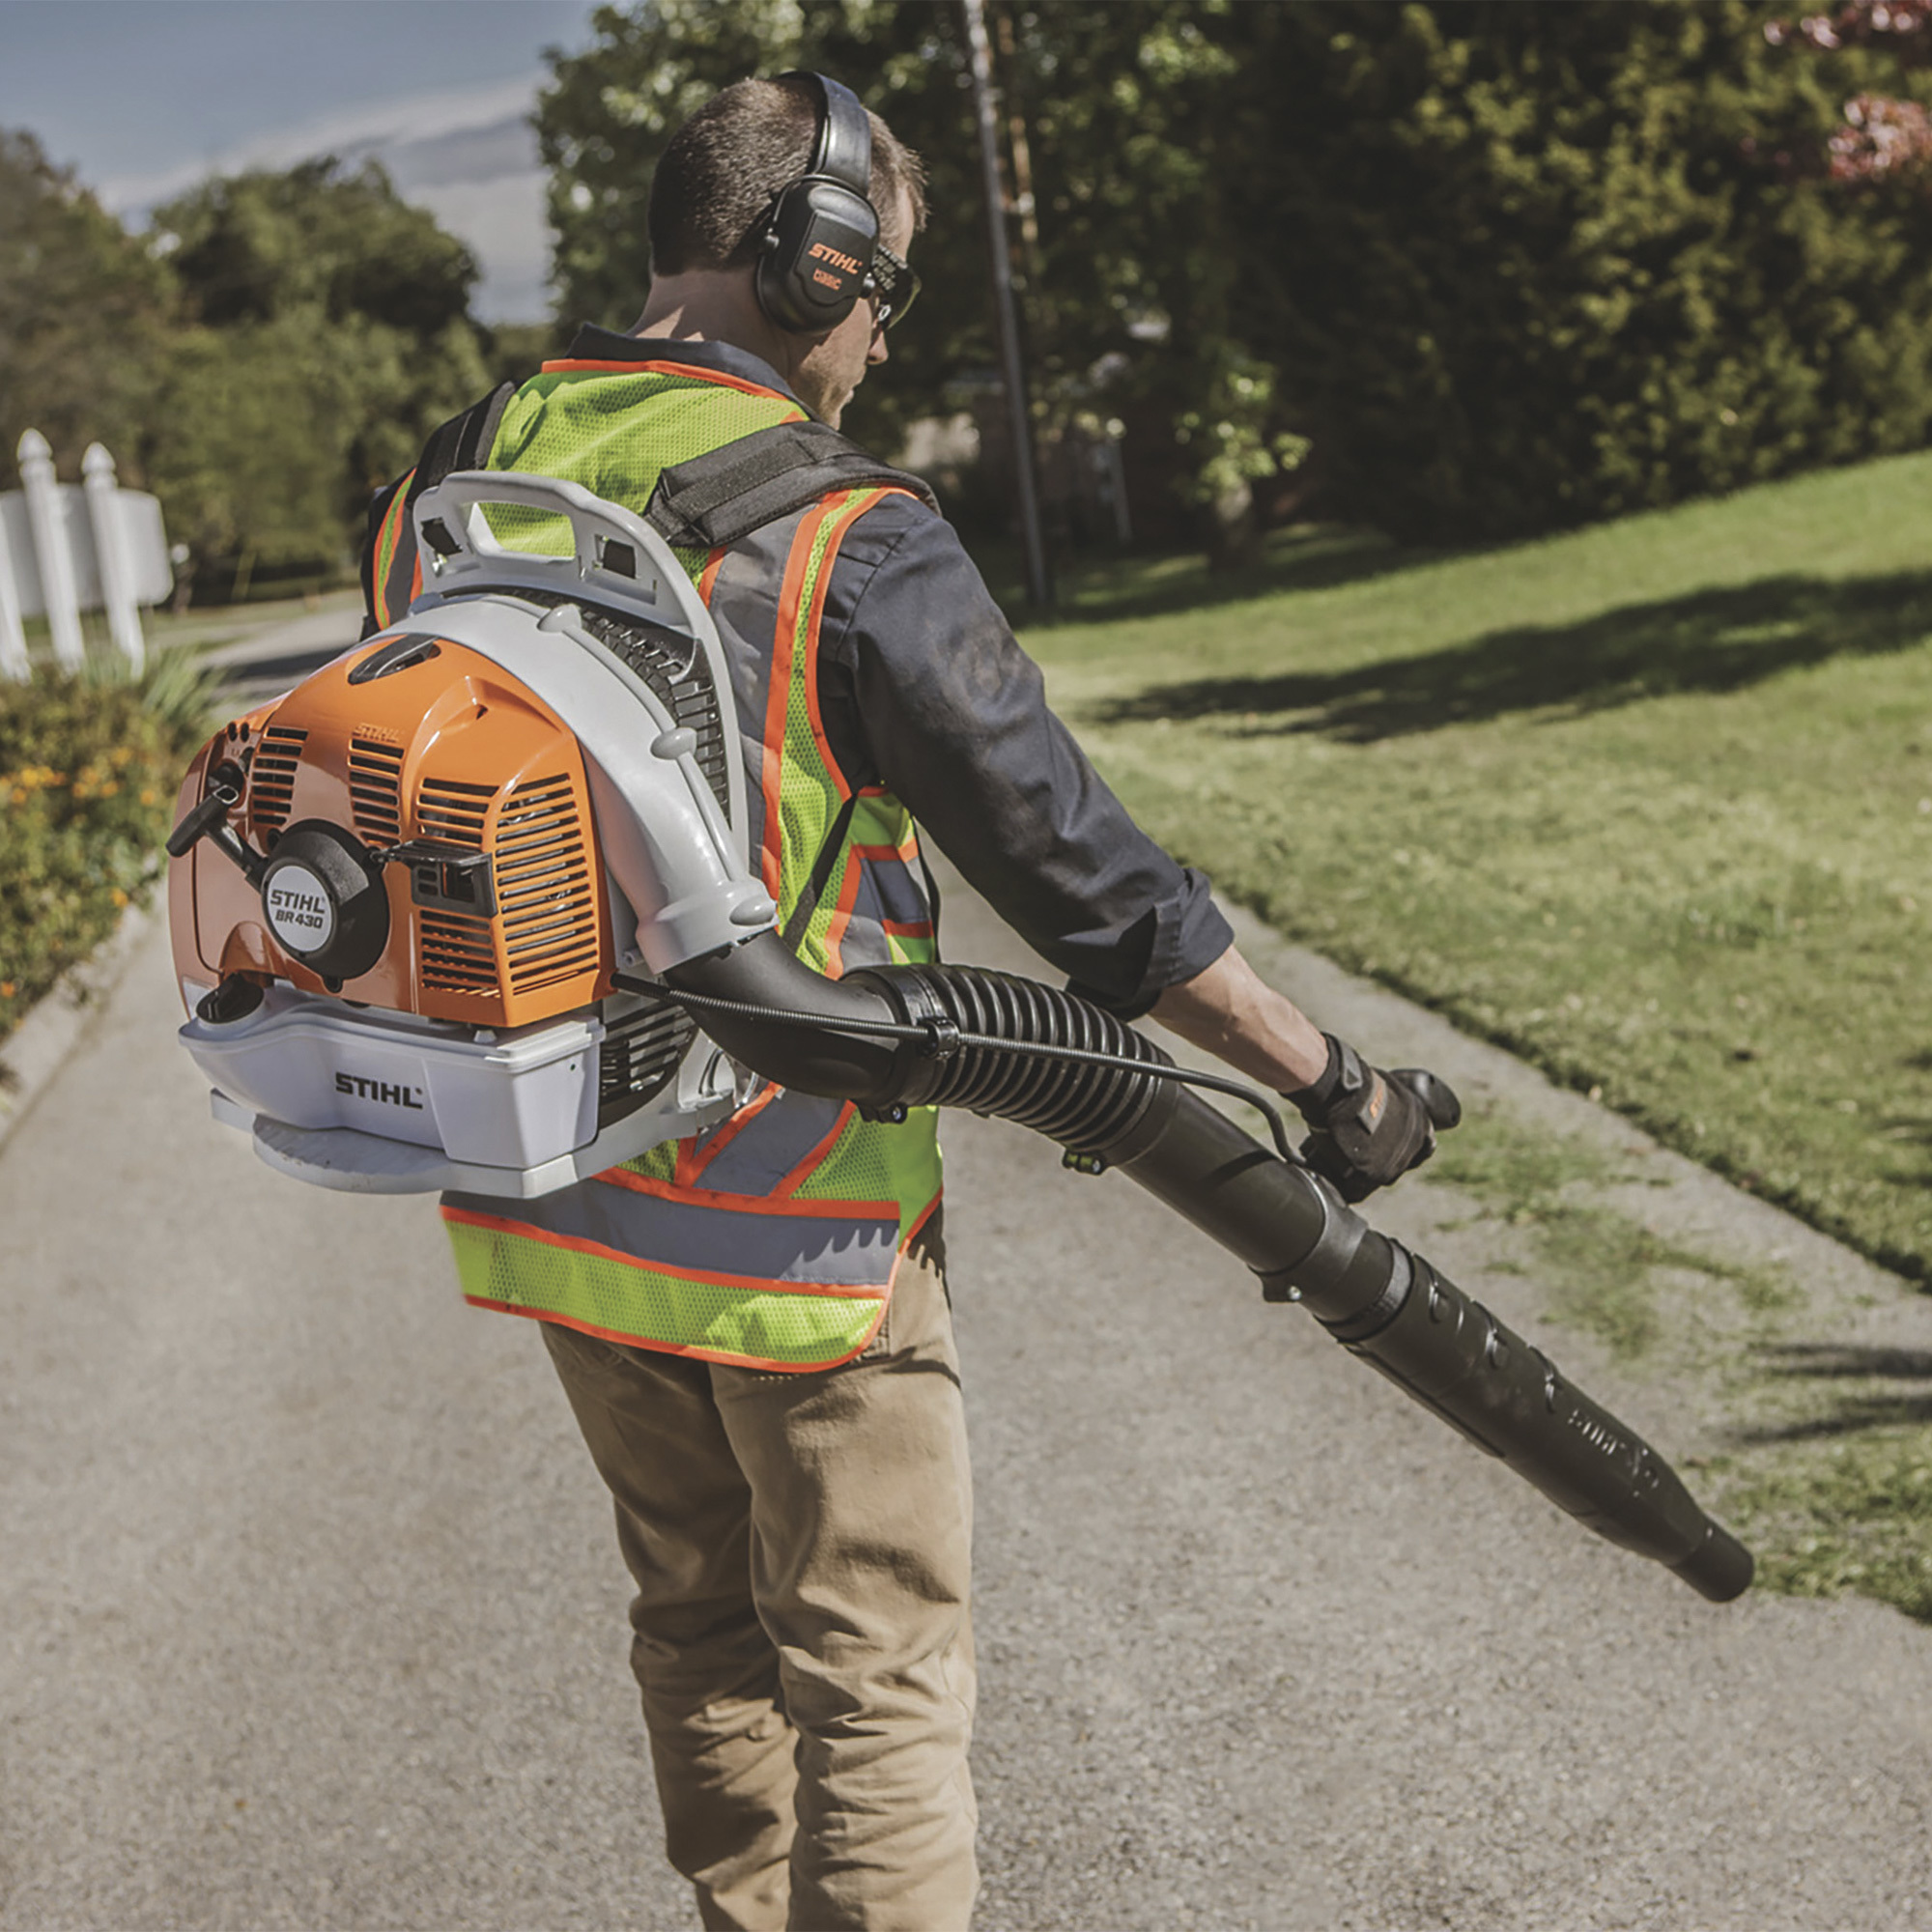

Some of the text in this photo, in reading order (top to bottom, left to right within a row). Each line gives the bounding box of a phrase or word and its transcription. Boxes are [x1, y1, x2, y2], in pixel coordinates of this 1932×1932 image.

[809, 242, 859, 274] STIHL
[270, 889, 326, 914] STIHL
[275, 909, 324, 929] BR 430
[335, 1071, 423, 1110] STIHL
